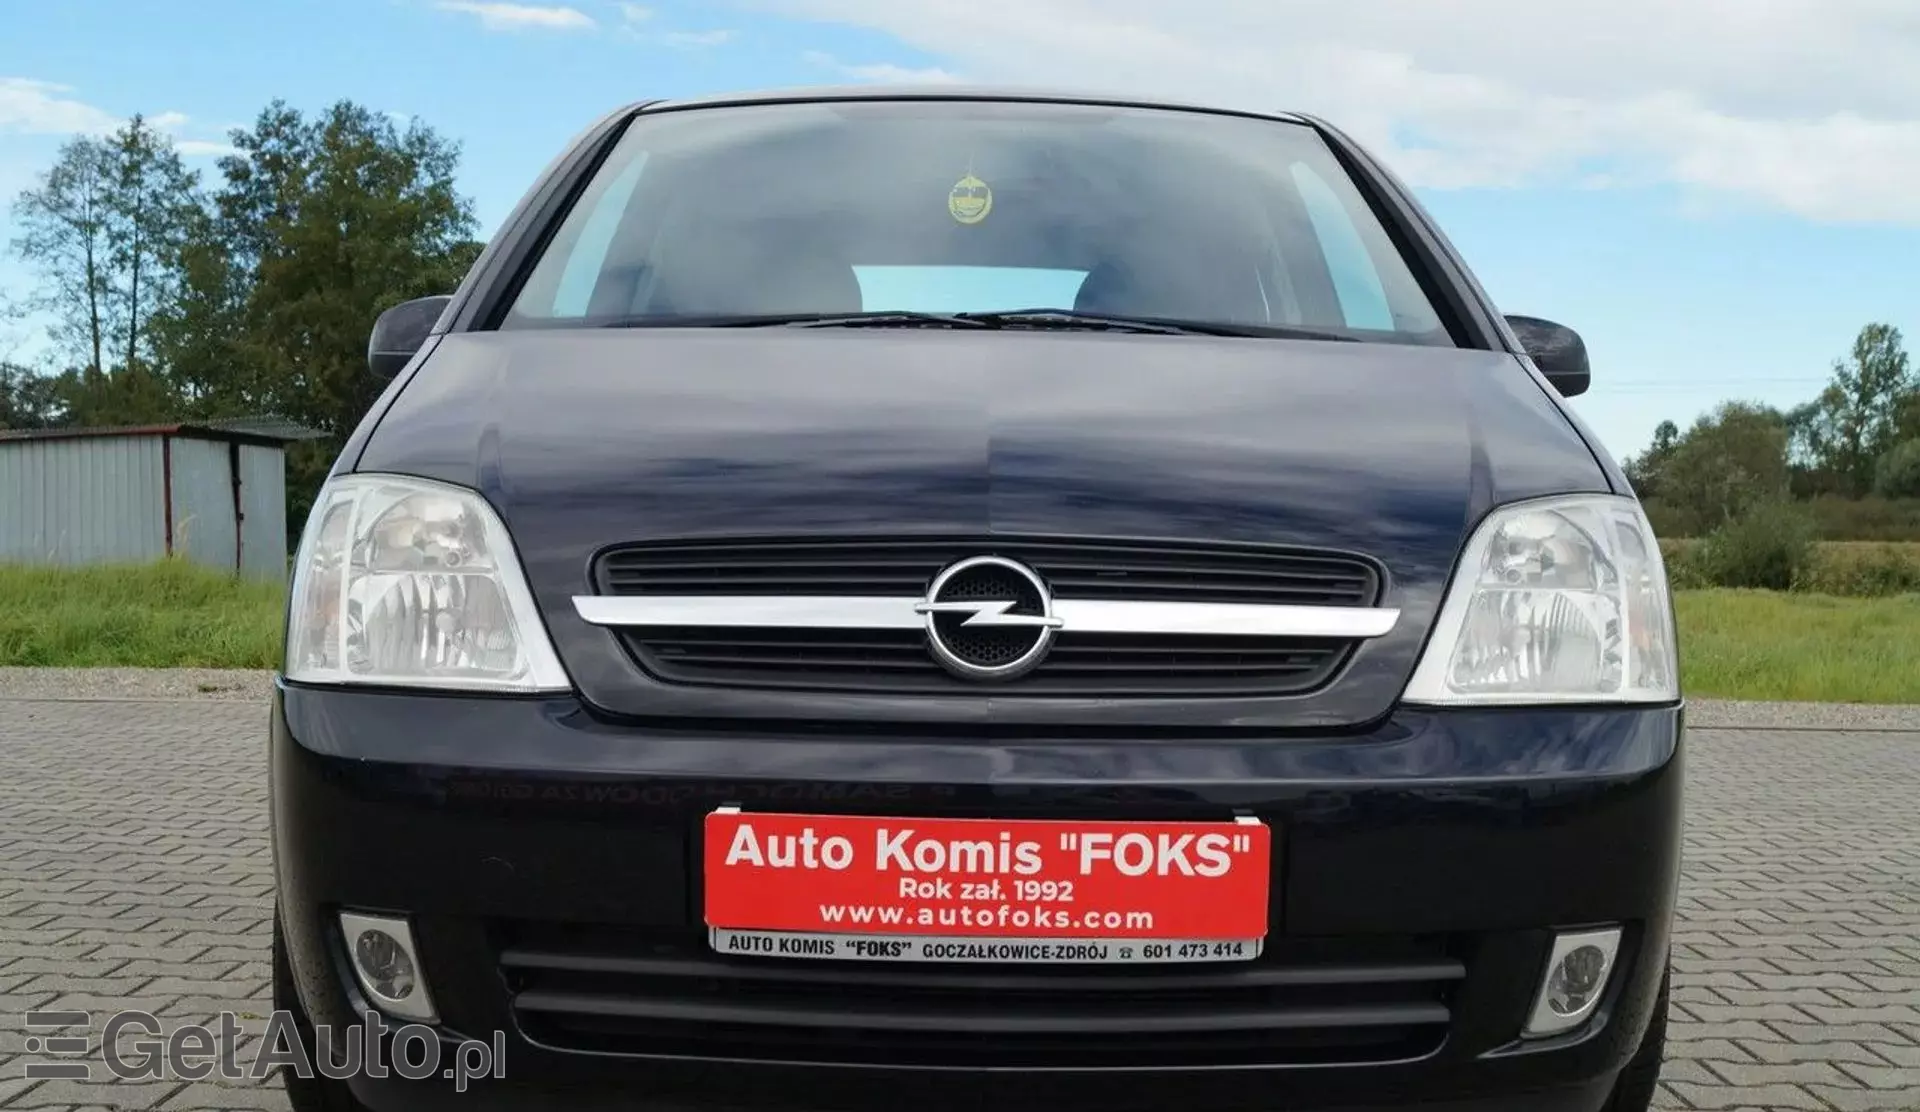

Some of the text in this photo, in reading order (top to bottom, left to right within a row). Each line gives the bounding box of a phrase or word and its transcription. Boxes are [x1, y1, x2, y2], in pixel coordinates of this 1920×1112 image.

[726, 825, 1250, 876] Auto Komis "FOKS"
[900, 877, 1073, 902] Rok zał. 1992
[820, 904, 1153, 929] www.autofoks.com
[729, 934, 773, 952] AUTO
[779, 937, 835, 955] KOMIS
[923, 942, 1107, 960] GOCZAŁKOWICE-ZDRÓJ
[1143, 944, 1172, 959] 601
[1178, 943, 1208, 958] 473
[1213, 942, 1243, 957] 414
